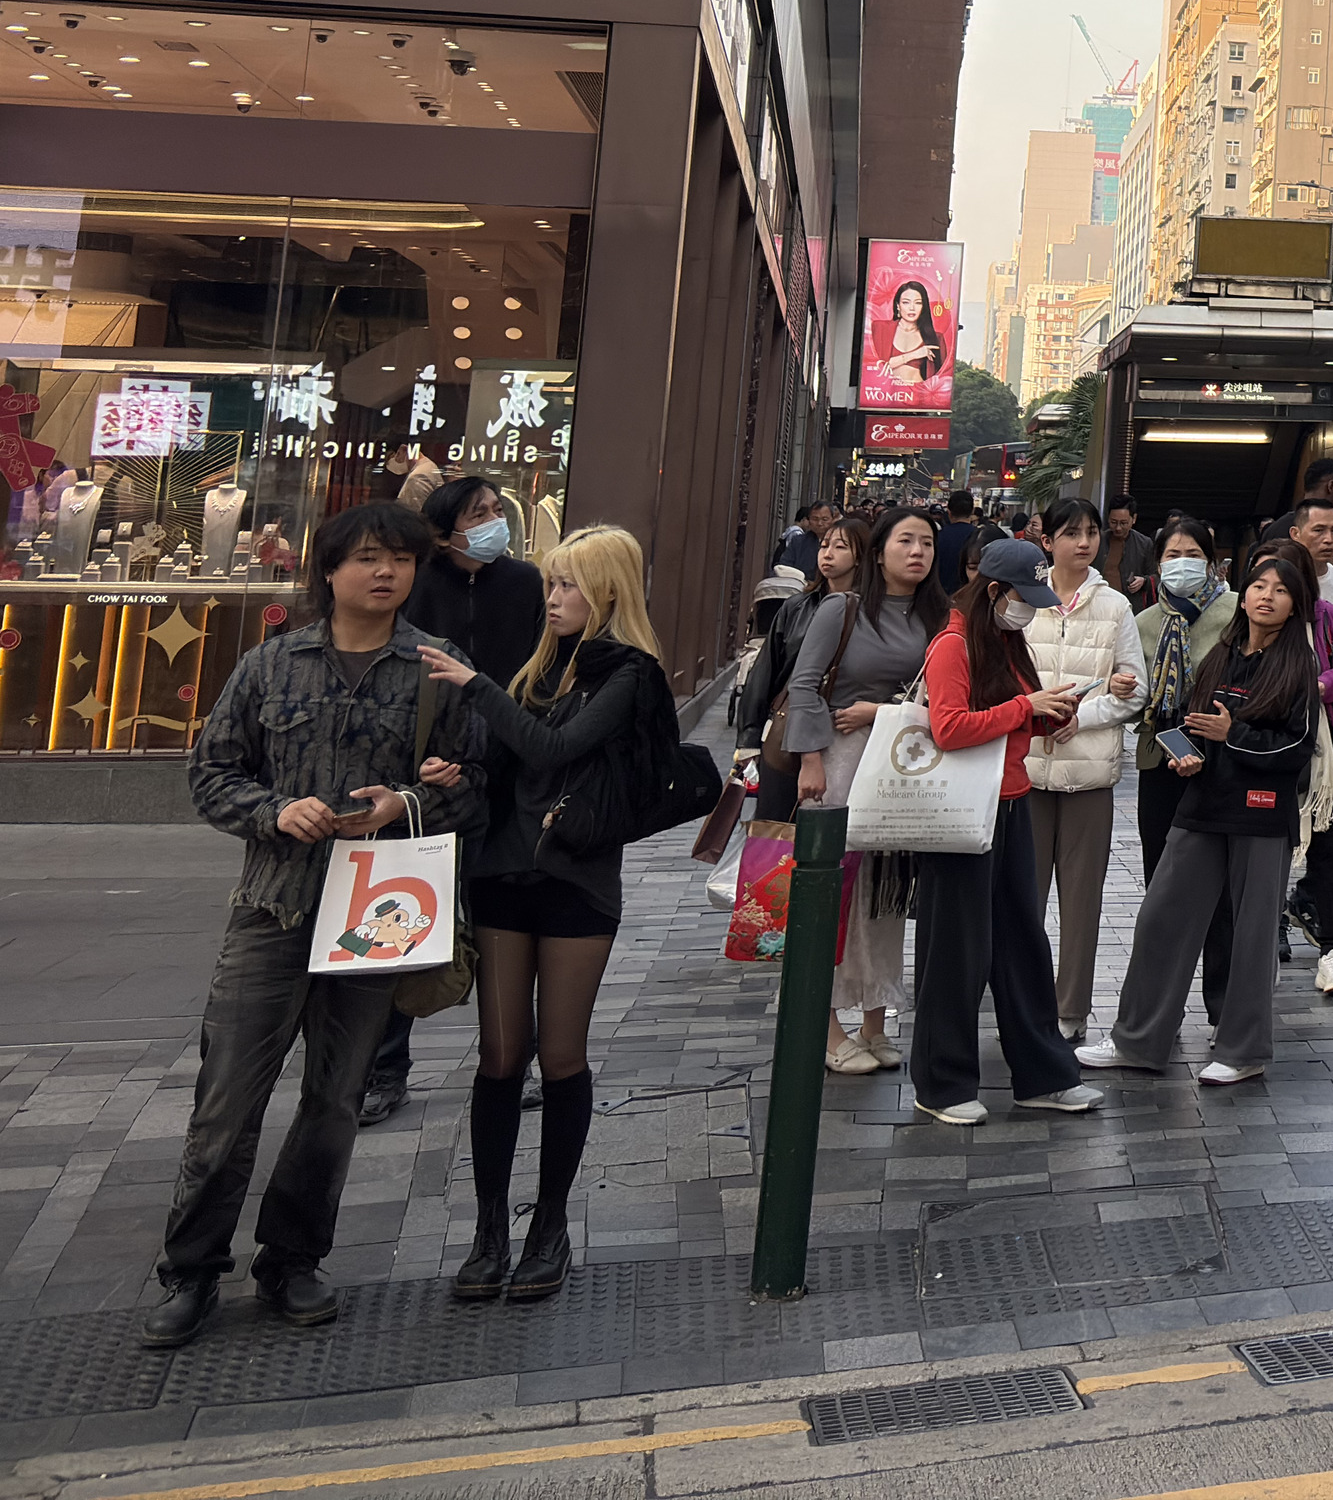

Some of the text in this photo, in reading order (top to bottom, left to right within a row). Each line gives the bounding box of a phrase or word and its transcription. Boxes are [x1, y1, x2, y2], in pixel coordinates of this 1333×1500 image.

[1223, 382, 1263, 393] 尖沙咀站
[865, 391, 914, 402] WOMEN
[87, 594, 168, 603] CHOW TAI FOOK
[876, 789, 947, 800] Medicare Group
